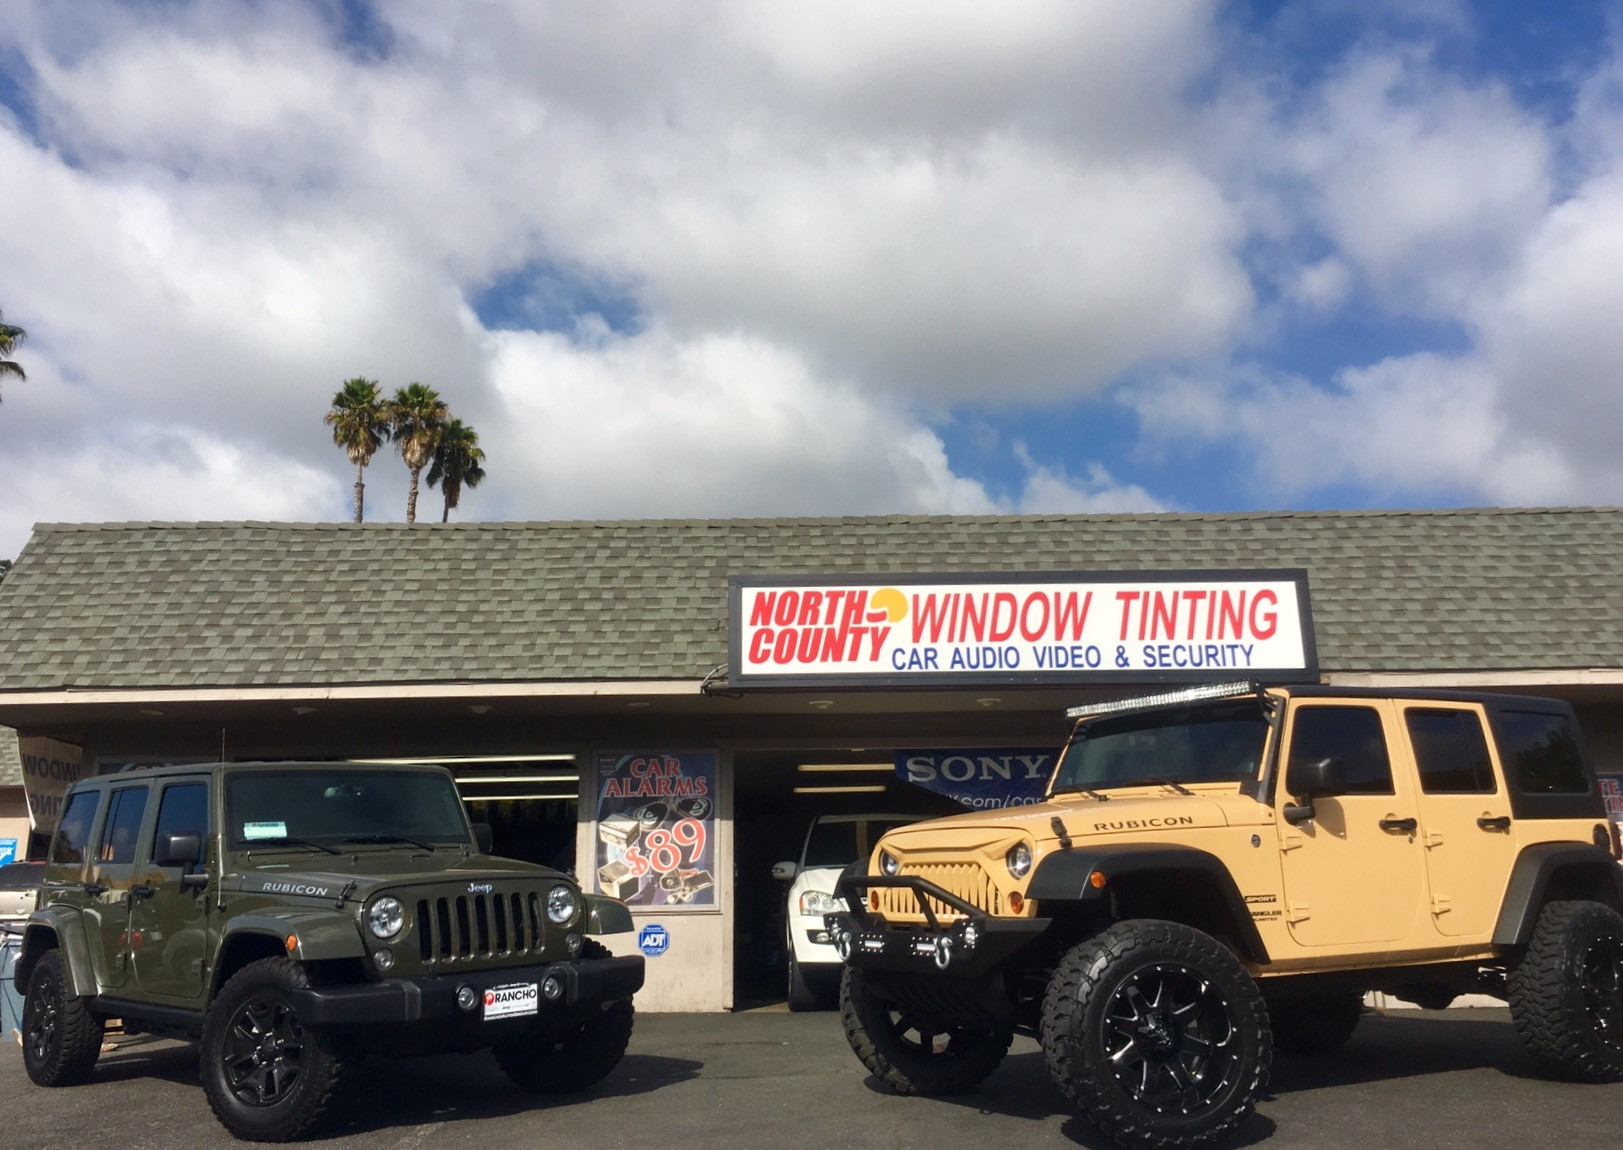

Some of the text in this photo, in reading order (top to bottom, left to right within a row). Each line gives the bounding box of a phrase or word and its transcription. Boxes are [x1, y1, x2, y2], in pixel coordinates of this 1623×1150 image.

[749, 590, 868, 626] NORTH
[912, 588, 1278, 644] WINDOW TINTING
[748, 625, 891, 664] COUNTY
[892, 644, 1254, 670] CAR AUDIO VIDEO & SECURITY
[630, 758, 681, 778] CAR
[906, 755, 1050, 782] SONY
[604, 776, 708, 797] ALARMS
[1093, 816, 1194, 831] RUBICON
[625, 818, 706, 877] $89
[262, 882, 328, 896] RUBICON
[467, 882, 493, 894] Jeep
[1245, 895, 1276, 903] SPORT
[642, 933, 666, 947] ADT
[495, 989, 537, 1003] RANCHO
